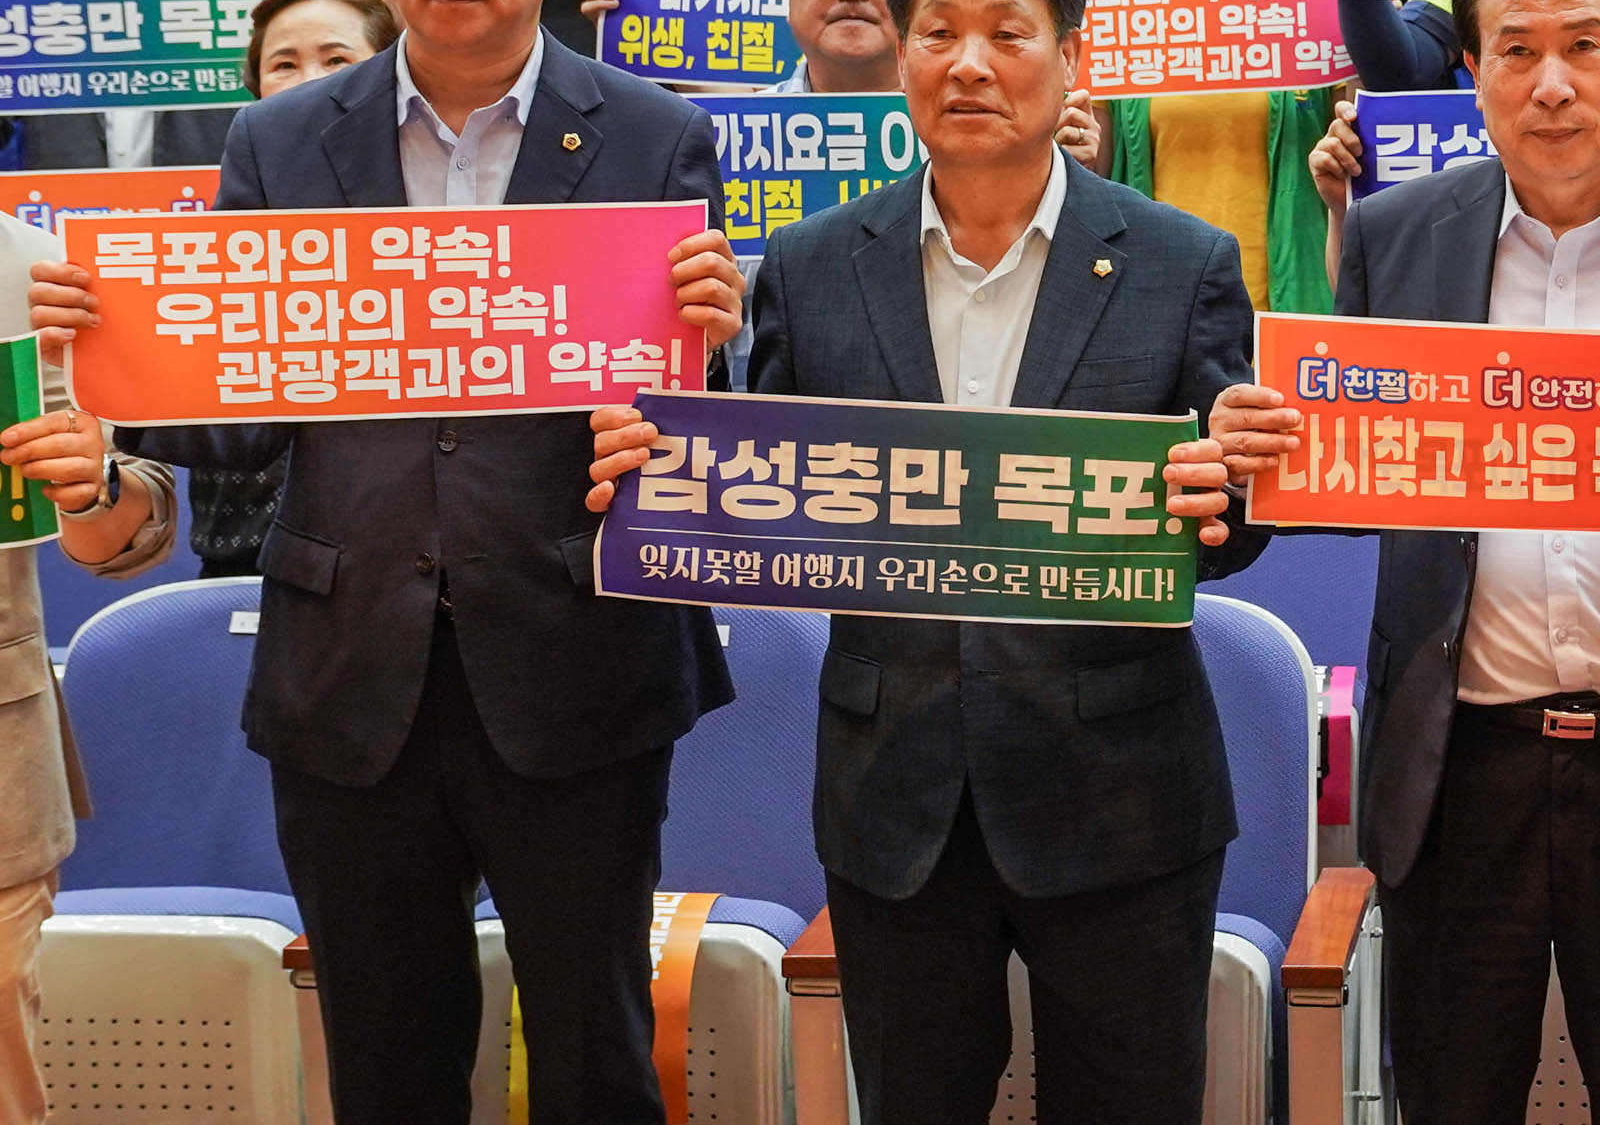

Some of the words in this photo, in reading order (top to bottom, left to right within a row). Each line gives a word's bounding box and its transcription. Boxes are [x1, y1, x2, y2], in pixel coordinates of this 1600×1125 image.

[618, 14, 695, 71] 위생,
[706, 18, 785, 74] 친절,
[1218, 1, 1308, 39] 약속!
[17, 70, 82, 99] 여행지
[87, 69, 191, 96] 우리손으로
[1088, 40, 1282, 89] 관광객과의
[95, 227, 347, 285] 목포와의
[370, 224, 511, 280] 약속!
[155, 287, 405, 345] 우리와의
[427, 283, 568, 339] 약속!
[215, 343, 526, 404] 관광객과의
[547, 337, 683, 391] 약속!
[1296, 341, 1339, 403] 더
[1341, 364, 1472, 404] 친절하고
[1481, 351, 1524, 411] 더
[635, 435, 971, 526] 감성충만
[1277, 413, 1468, 499] 다시찾고
[1483, 421, 1579, 502] 싶은
[639, 541, 766, 587] 잊지못할
[771, 549, 865, 589] 여행지
[875, 555, 1031, 596] 우리손으로
[1039, 564, 1175, 603] 만듭시다!
